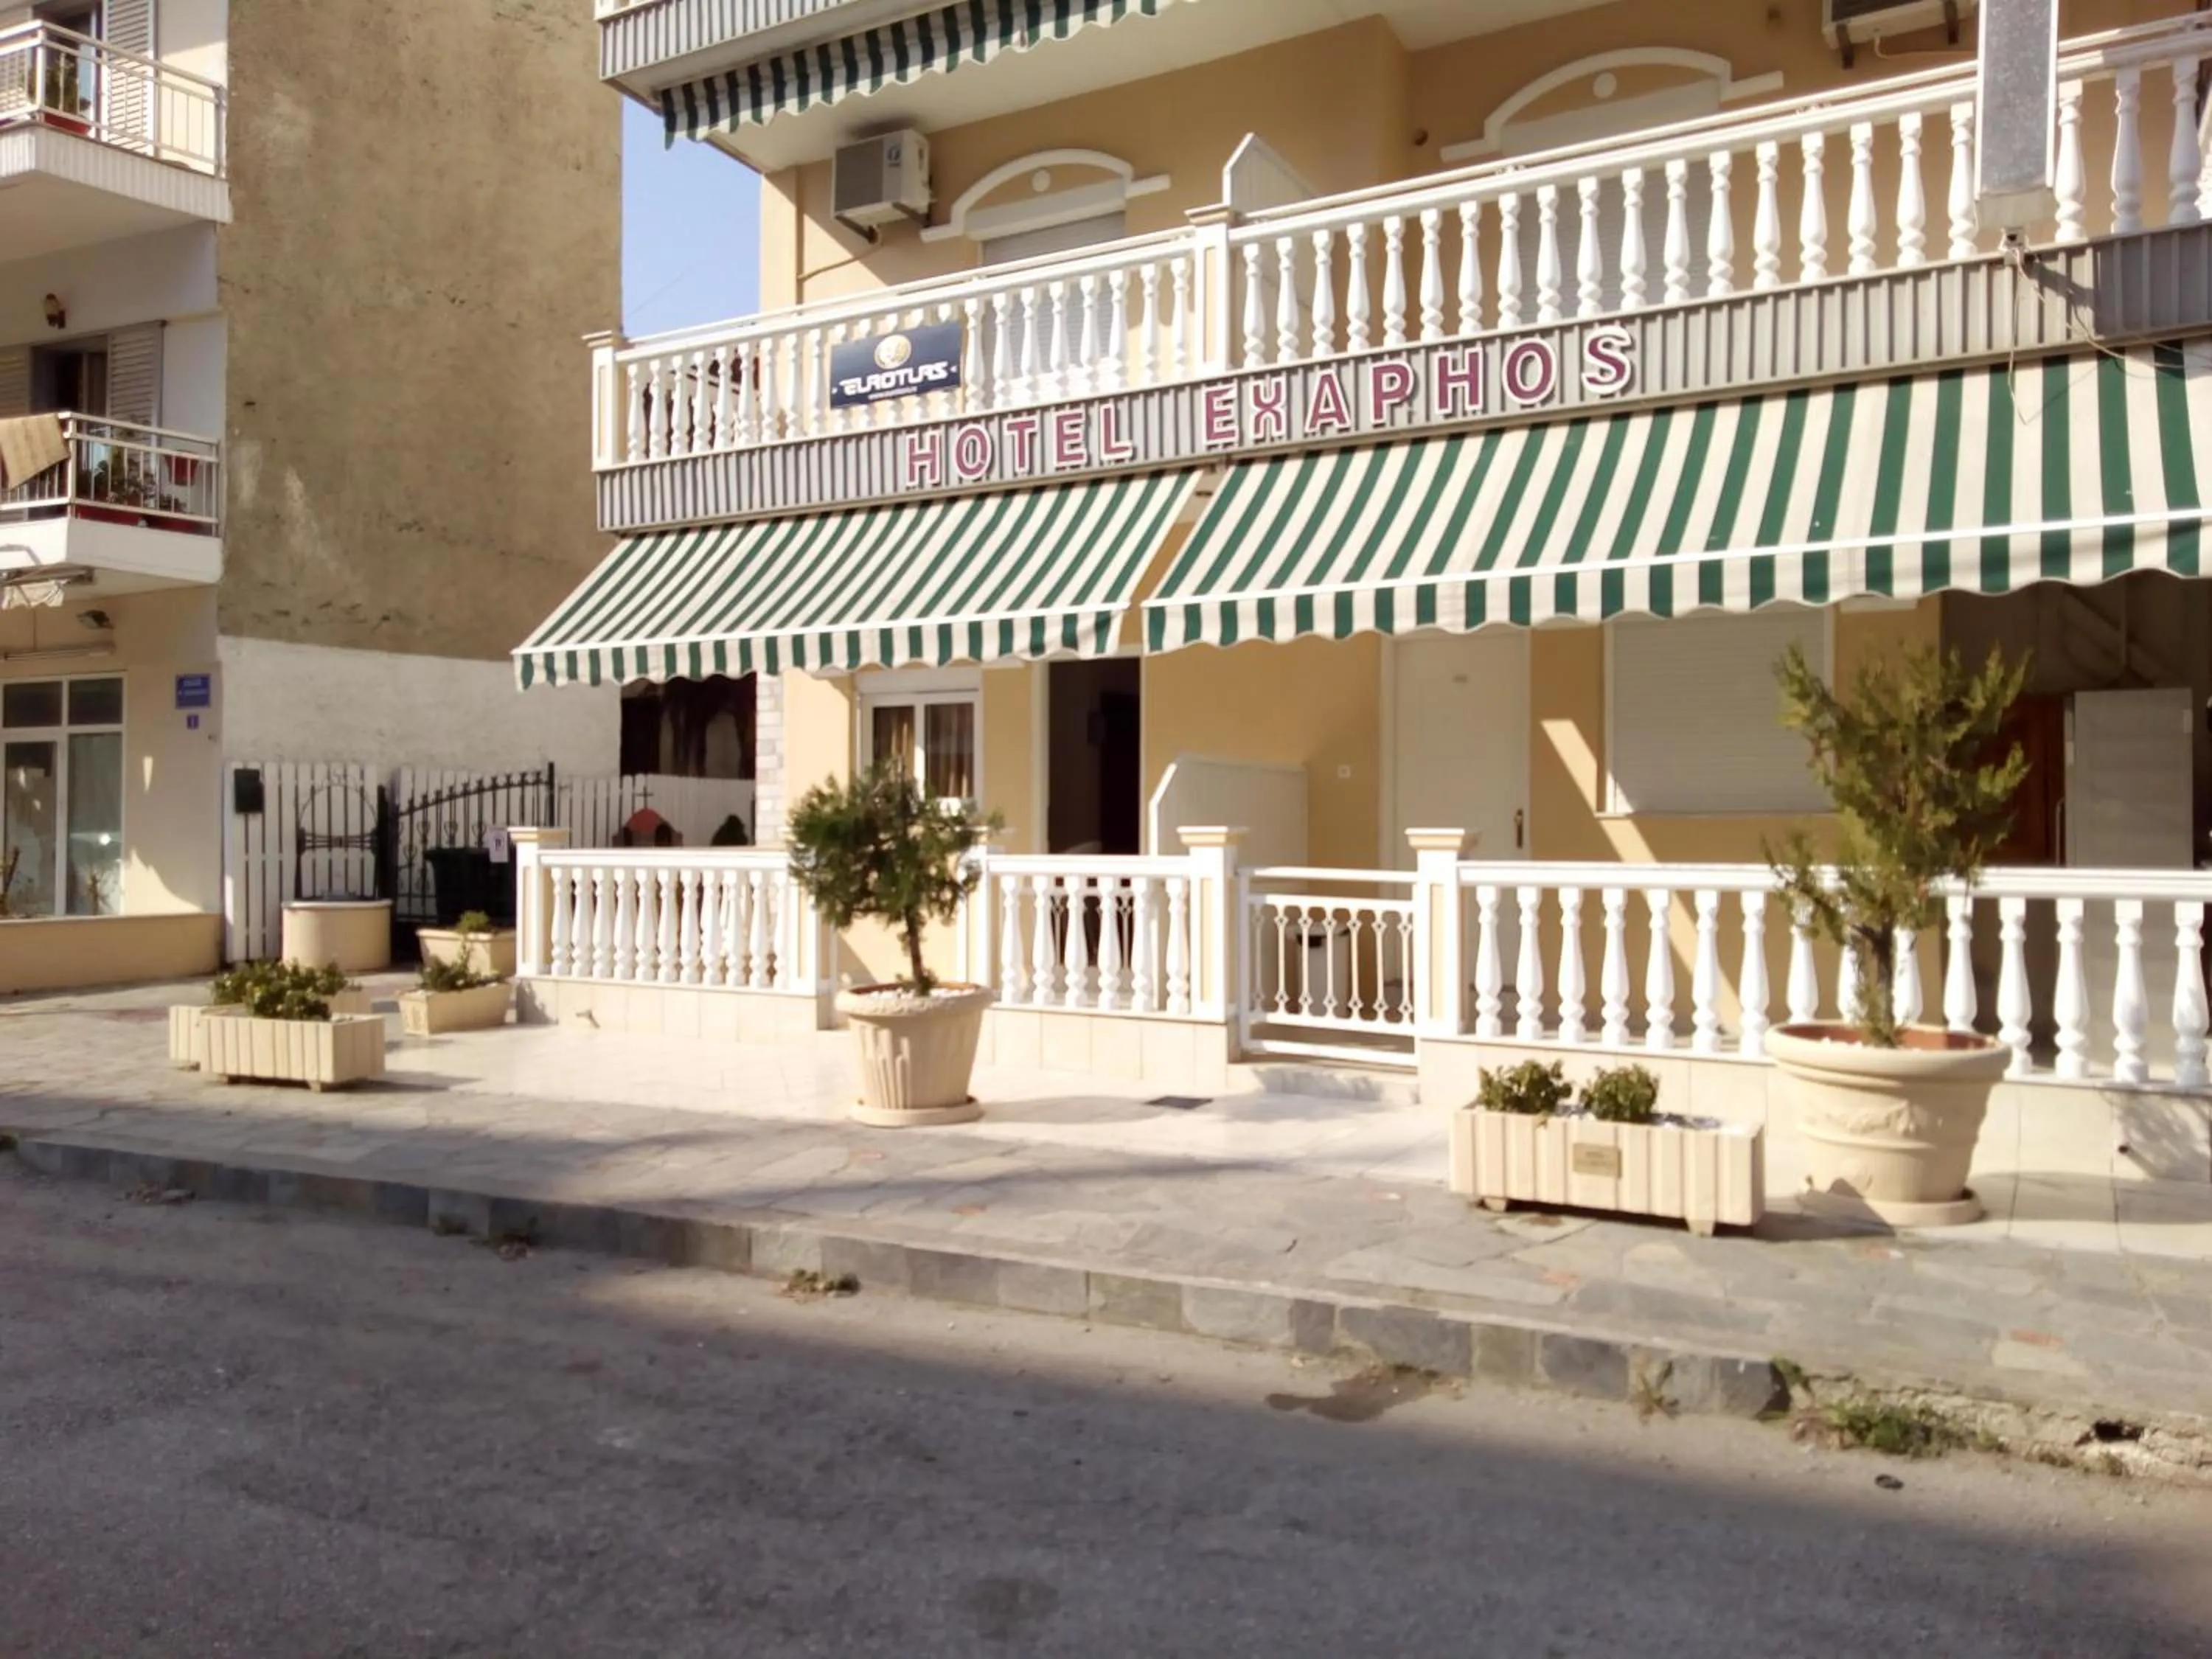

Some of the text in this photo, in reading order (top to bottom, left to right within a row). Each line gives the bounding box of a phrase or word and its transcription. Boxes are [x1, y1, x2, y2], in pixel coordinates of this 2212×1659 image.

[839, 361, 948, 396] EUROTURS
[905, 325, 1632, 486] HOTEL EXAPHOS
